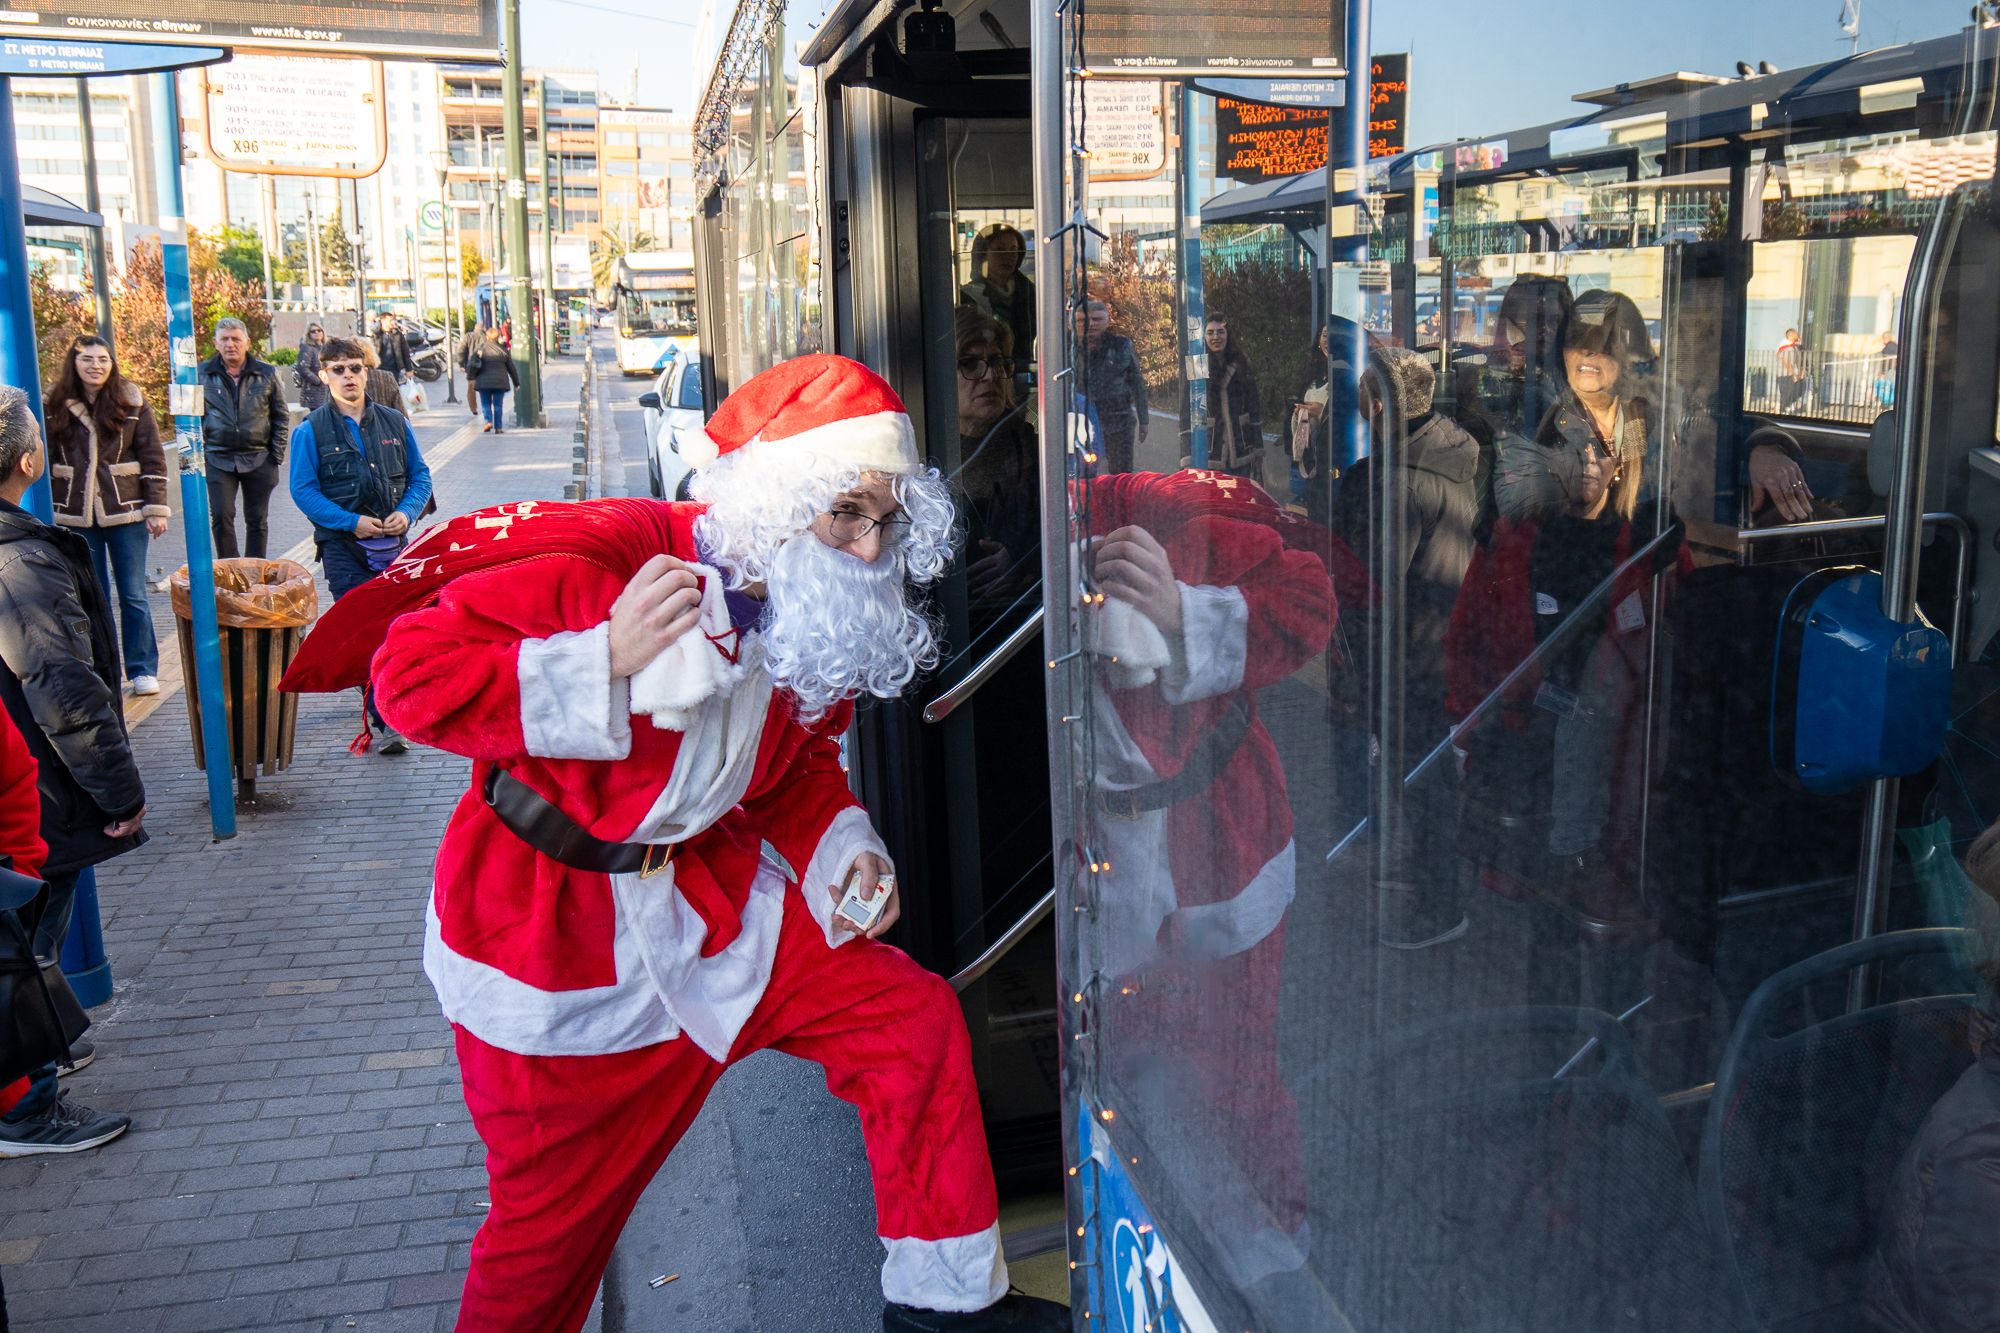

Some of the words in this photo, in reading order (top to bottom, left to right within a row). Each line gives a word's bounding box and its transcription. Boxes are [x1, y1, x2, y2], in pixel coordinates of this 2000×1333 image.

[301, 5, 389, 28] ΣΧΙΣΤΟ
[67, 16, 151, 32] συγκοινωνίες
[251, 25, 342, 42] www.tfa.gov.gr
[4, 43, 20, 55] ΣΤ.
[21, 45, 57, 57] ΜΕΤΡΟ
[58, 46, 104, 59] ΠΕΙΡΑΙΑΣ
[28, 59, 38, 68] ST
[41, 59, 69, 70] METRO
[69, 60, 105, 71] PEIRAIAS
[225, 71, 246, 80] 703
[227, 83, 248, 92] 843
[257, 85, 295, 94] ΠΕΡΑΜΑ
[305, 88, 347, 98] ΠΕΙΡΑΙΑΣ
[225, 105, 248, 113] 909
[227, 116, 250, 125] 915
[625, 114, 672, 125] ΖΩΝΑΣ
[223, 126, 245, 135] 400
[232, 139, 259, 154] X96
